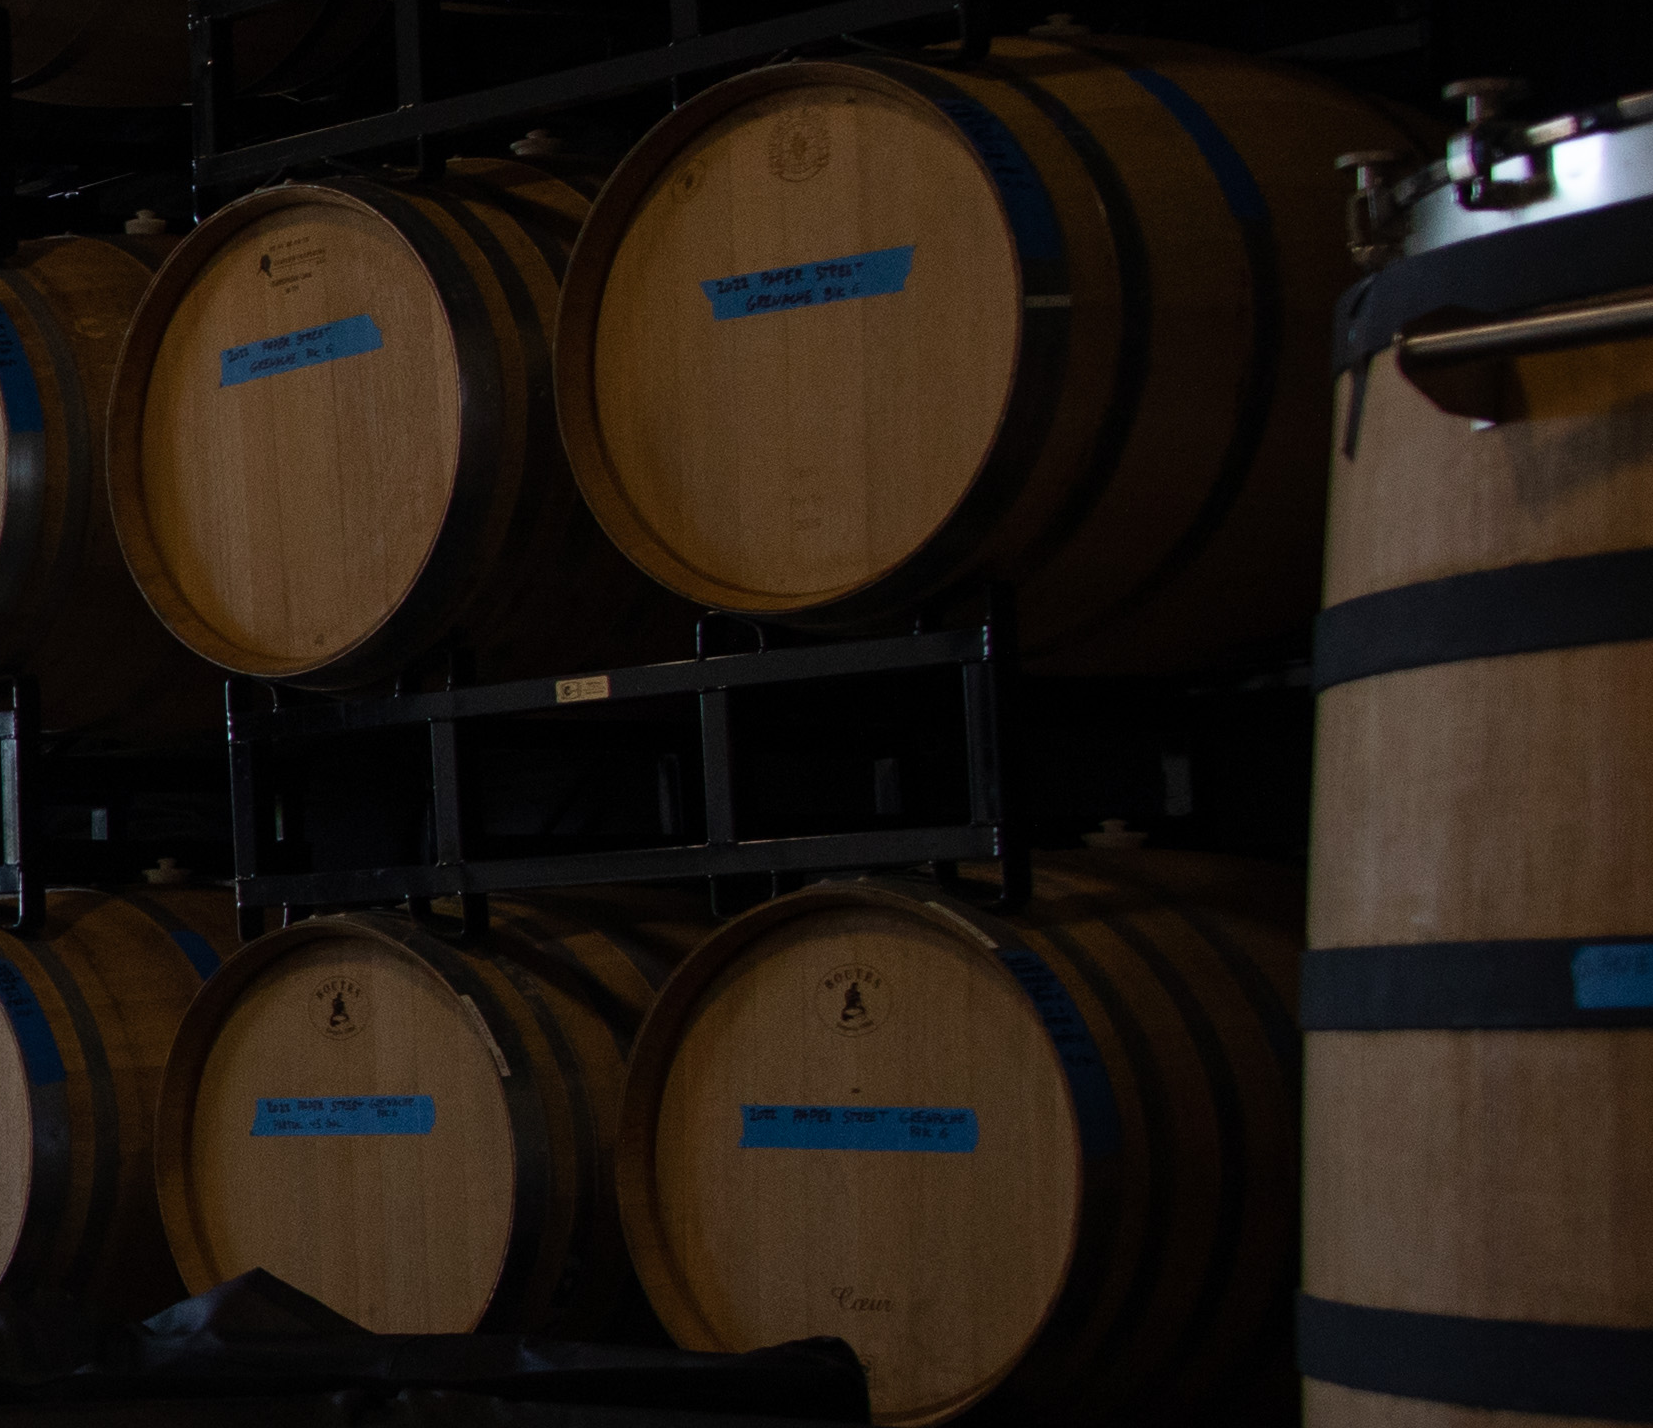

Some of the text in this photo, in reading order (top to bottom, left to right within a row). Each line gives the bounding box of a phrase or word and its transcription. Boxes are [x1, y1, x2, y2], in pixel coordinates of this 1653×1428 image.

[716, 261, 863, 294] 2022 PAPER STREET
[746, 288, 812, 312] GRENACHE
[793, 1109, 831, 1124] PAPER
[842, 1110, 889, 1124] STREET
[899, 1110, 966, 1125] GRENACHE
